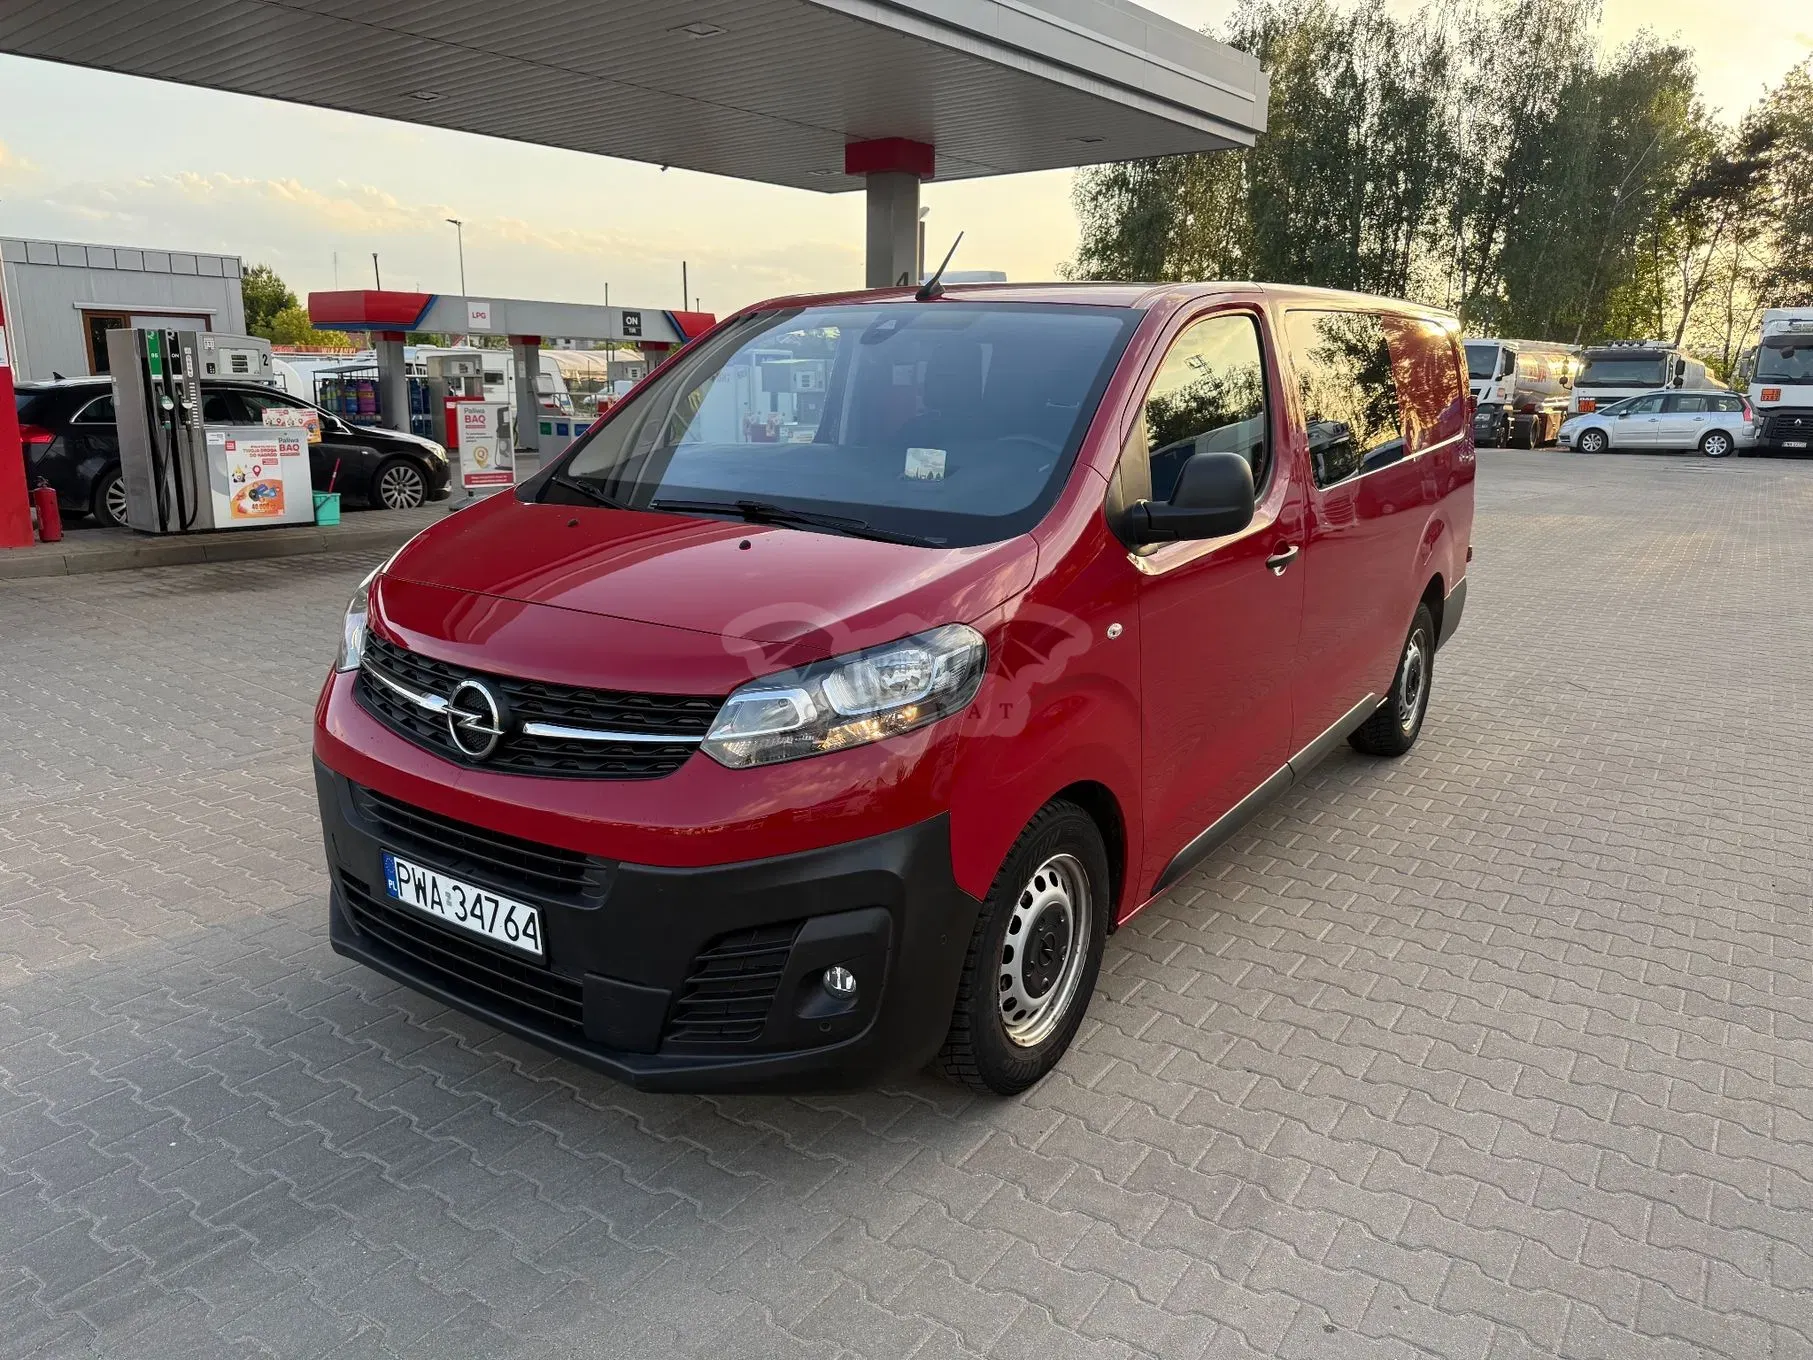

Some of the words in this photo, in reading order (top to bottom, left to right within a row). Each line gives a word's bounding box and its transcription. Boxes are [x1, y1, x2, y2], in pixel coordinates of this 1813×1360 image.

[896, 271, 909, 287] 4
[472, 311, 486, 319] LPG
[626, 316, 638, 325] ON
[262, 354, 269, 366] 2
[464, 415, 486, 424] BAQ
[388, 879, 397, 891] PL
